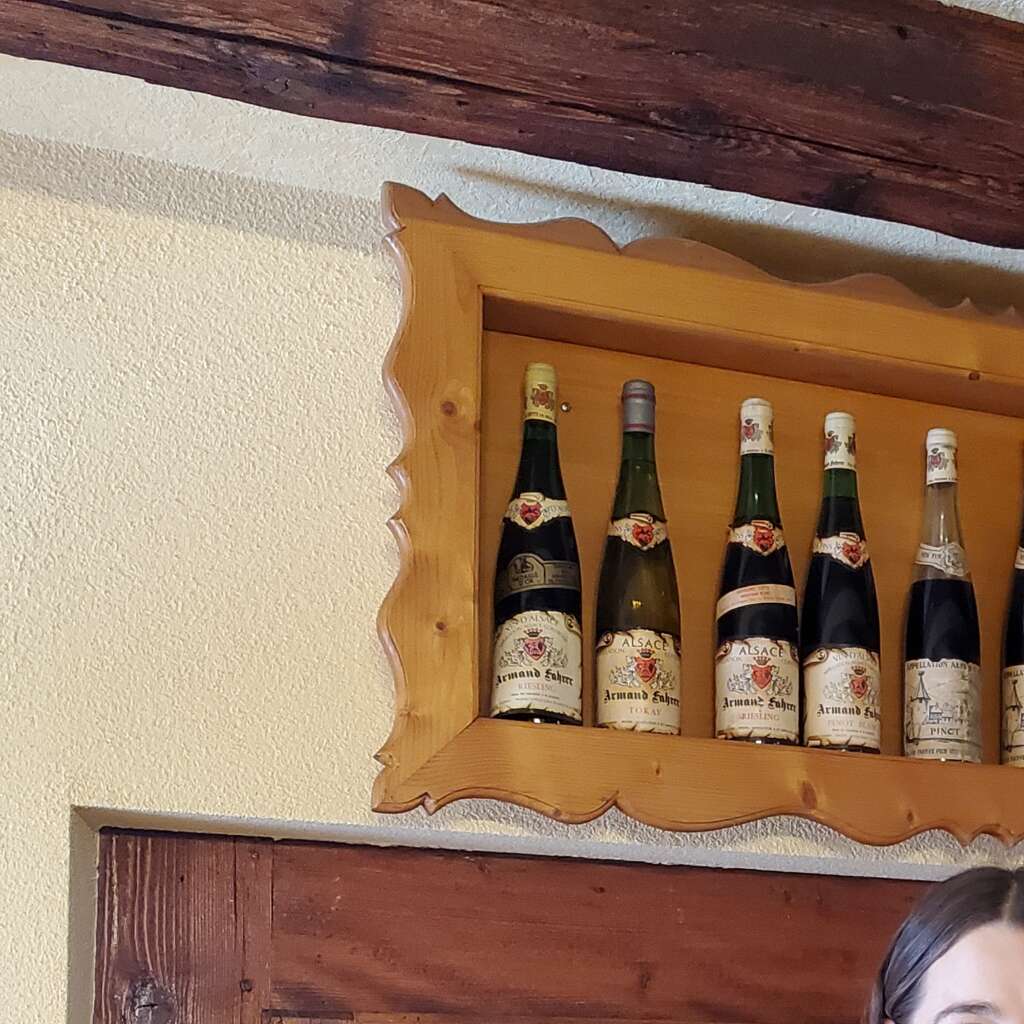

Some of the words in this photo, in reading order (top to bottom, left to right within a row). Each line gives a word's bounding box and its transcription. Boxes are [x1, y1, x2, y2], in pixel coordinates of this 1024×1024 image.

[622, 638, 669, 651] ALSACE
[739, 646, 784, 658] ALSACE
[496, 668, 541, 688] Armand
[604, 689, 649, 704] Armand
[722, 696, 765, 711] Armand
[629, 706, 662, 716] TOKAY
[816, 703, 861, 717] Armand
